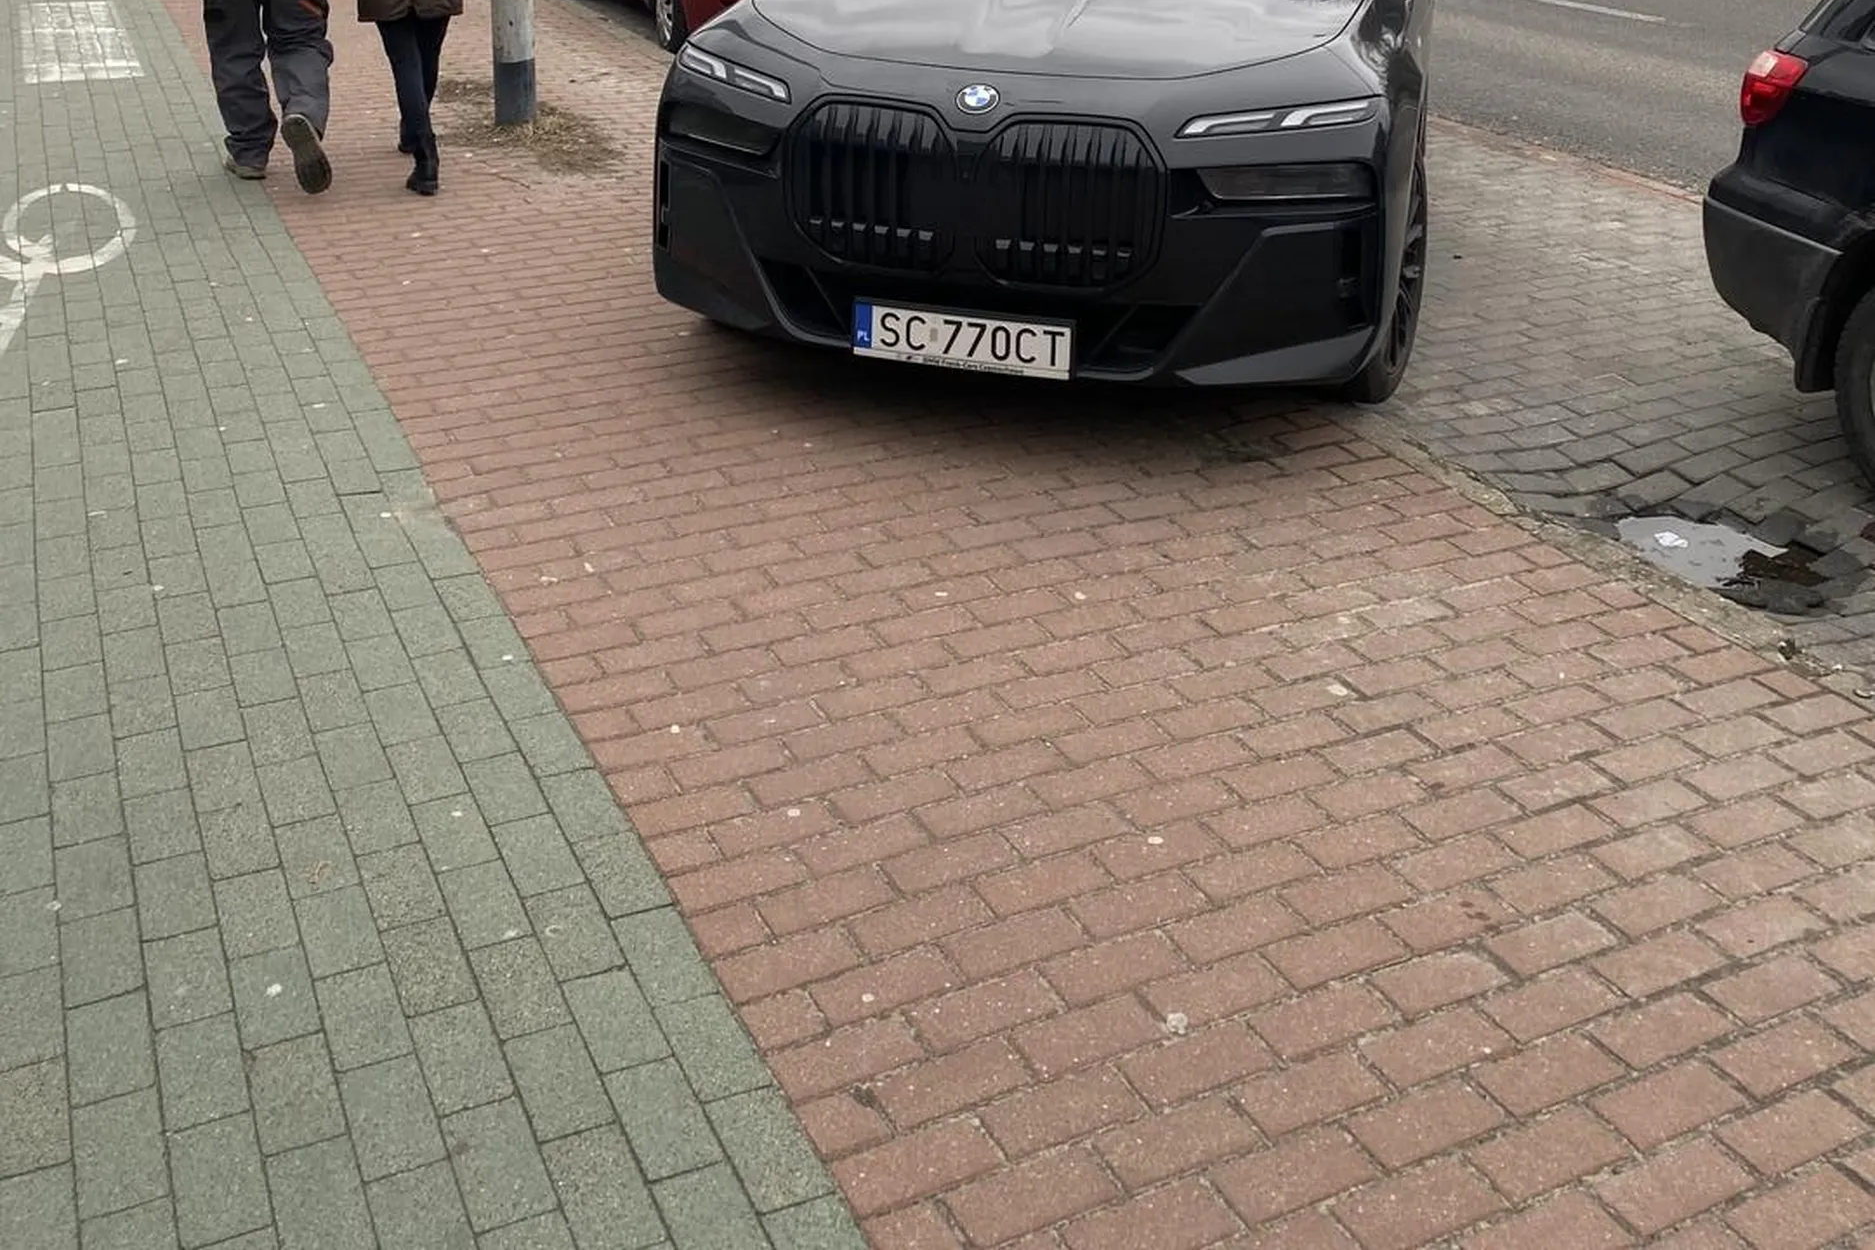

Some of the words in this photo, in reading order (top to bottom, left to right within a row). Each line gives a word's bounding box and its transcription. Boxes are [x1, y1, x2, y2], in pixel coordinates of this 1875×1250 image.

[856, 331, 870, 342] PL
[880, 312, 926, 351] SC
[942, 319, 1066, 367] 770CT
